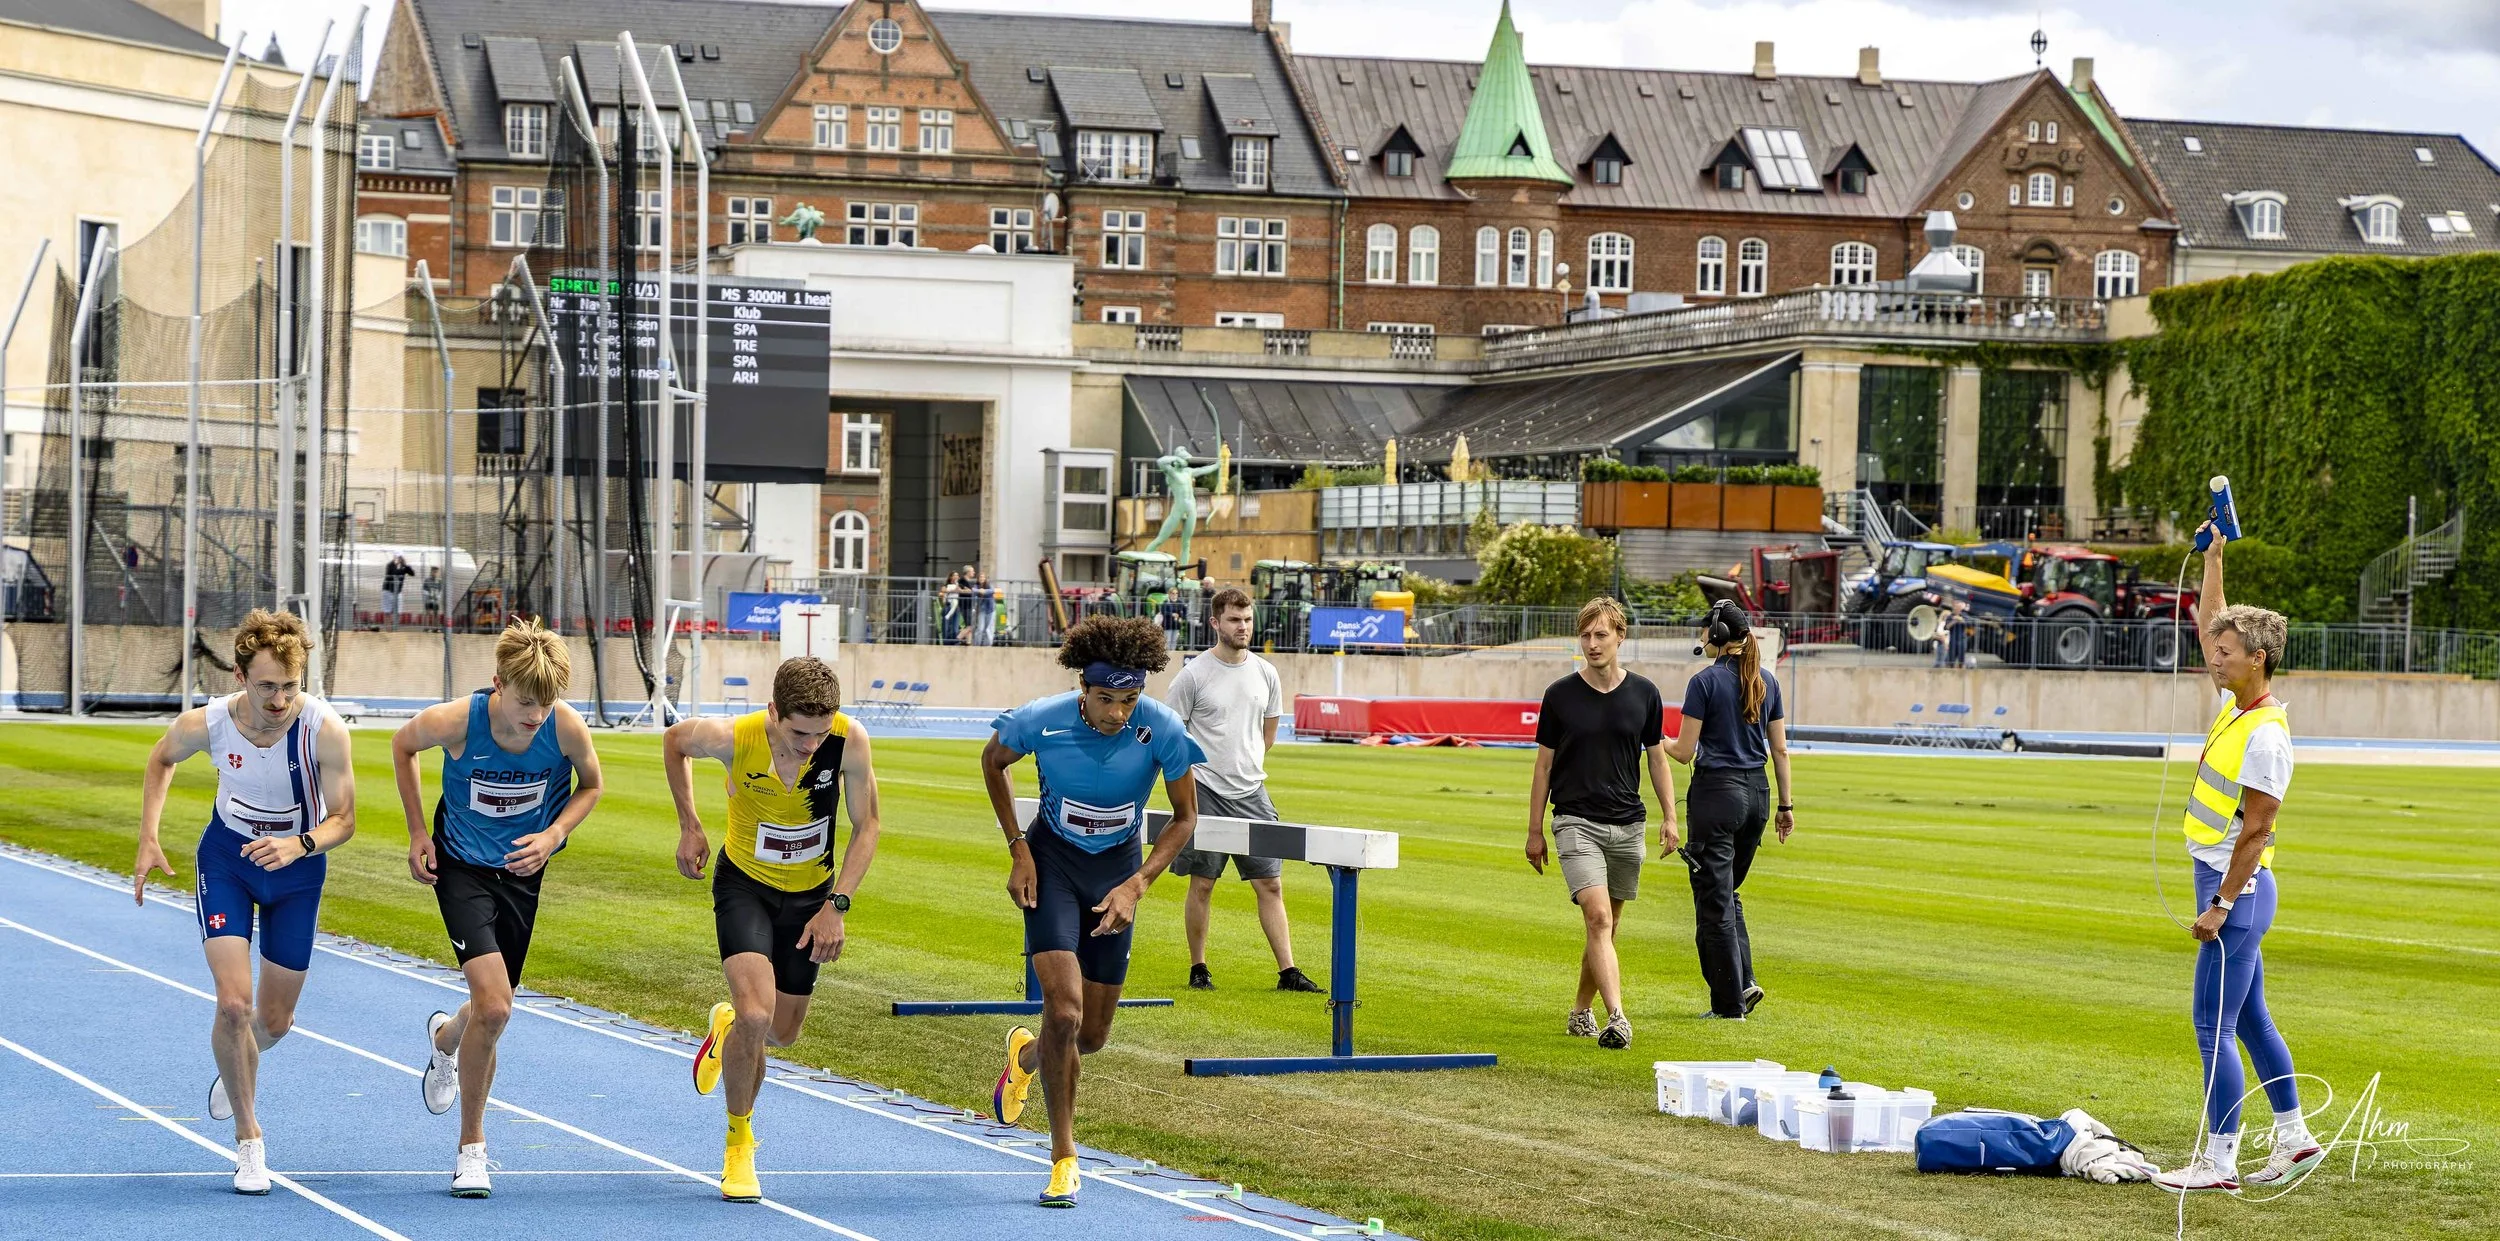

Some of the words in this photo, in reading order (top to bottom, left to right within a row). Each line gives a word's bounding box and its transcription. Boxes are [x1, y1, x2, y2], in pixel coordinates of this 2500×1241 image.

[550, 296, 566, 309] Nr
[721, 288, 741, 301] MS
[747, 289, 787, 304] 3000H
[794, 292, 802, 305] 1
[804, 292, 831, 306] heat
[734, 306, 761, 320] Klub
[733, 323, 758, 336] SPA
[733, 339, 758, 352] TRE
[733, 355, 757, 368] SPA
[732, 371, 759, 384] ARH
[1337, 621, 1361, 629] Dansk
[471, 768, 552, 783] SPARTA
[785, 842, 803, 850] 188
